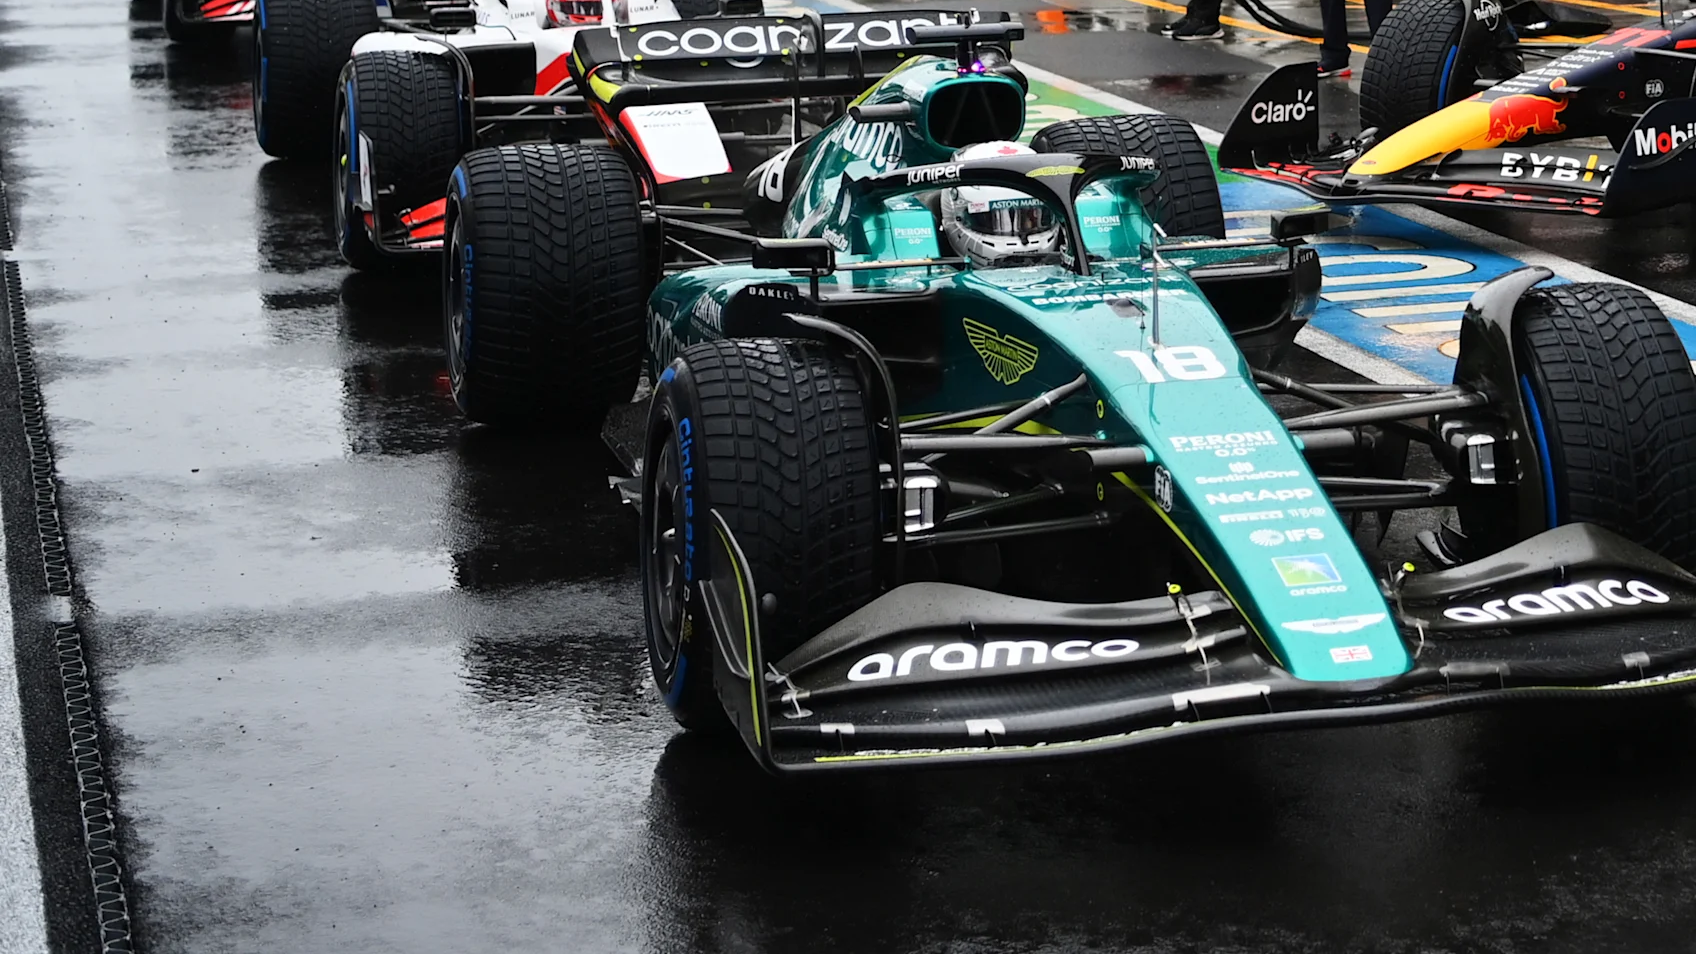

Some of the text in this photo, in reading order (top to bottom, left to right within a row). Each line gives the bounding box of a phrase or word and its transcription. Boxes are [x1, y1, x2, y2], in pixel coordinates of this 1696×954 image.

[1251, 100, 1307, 124] Claro
[991, 200, 1019, 210] ASTON
[1083, 215, 1121, 226] PERONI
[894, 227, 932, 237] PERONI
[748, 286, 796, 300] OAKLEY
[1114, 345, 1227, 384] 18
[1168, 430, 1277, 450] PERONI
[1195, 470, 1300, 485] SentinelOne
[678, 417, 695, 582] Cinturato
[1206, 487, 1314, 506] NetApp
[1285, 527, 1325, 542] IFS
[1289, 585, 1348, 597] aramco
[1444, 579, 1670, 623] aramco
[847, 637, 1139, 682] aramco
